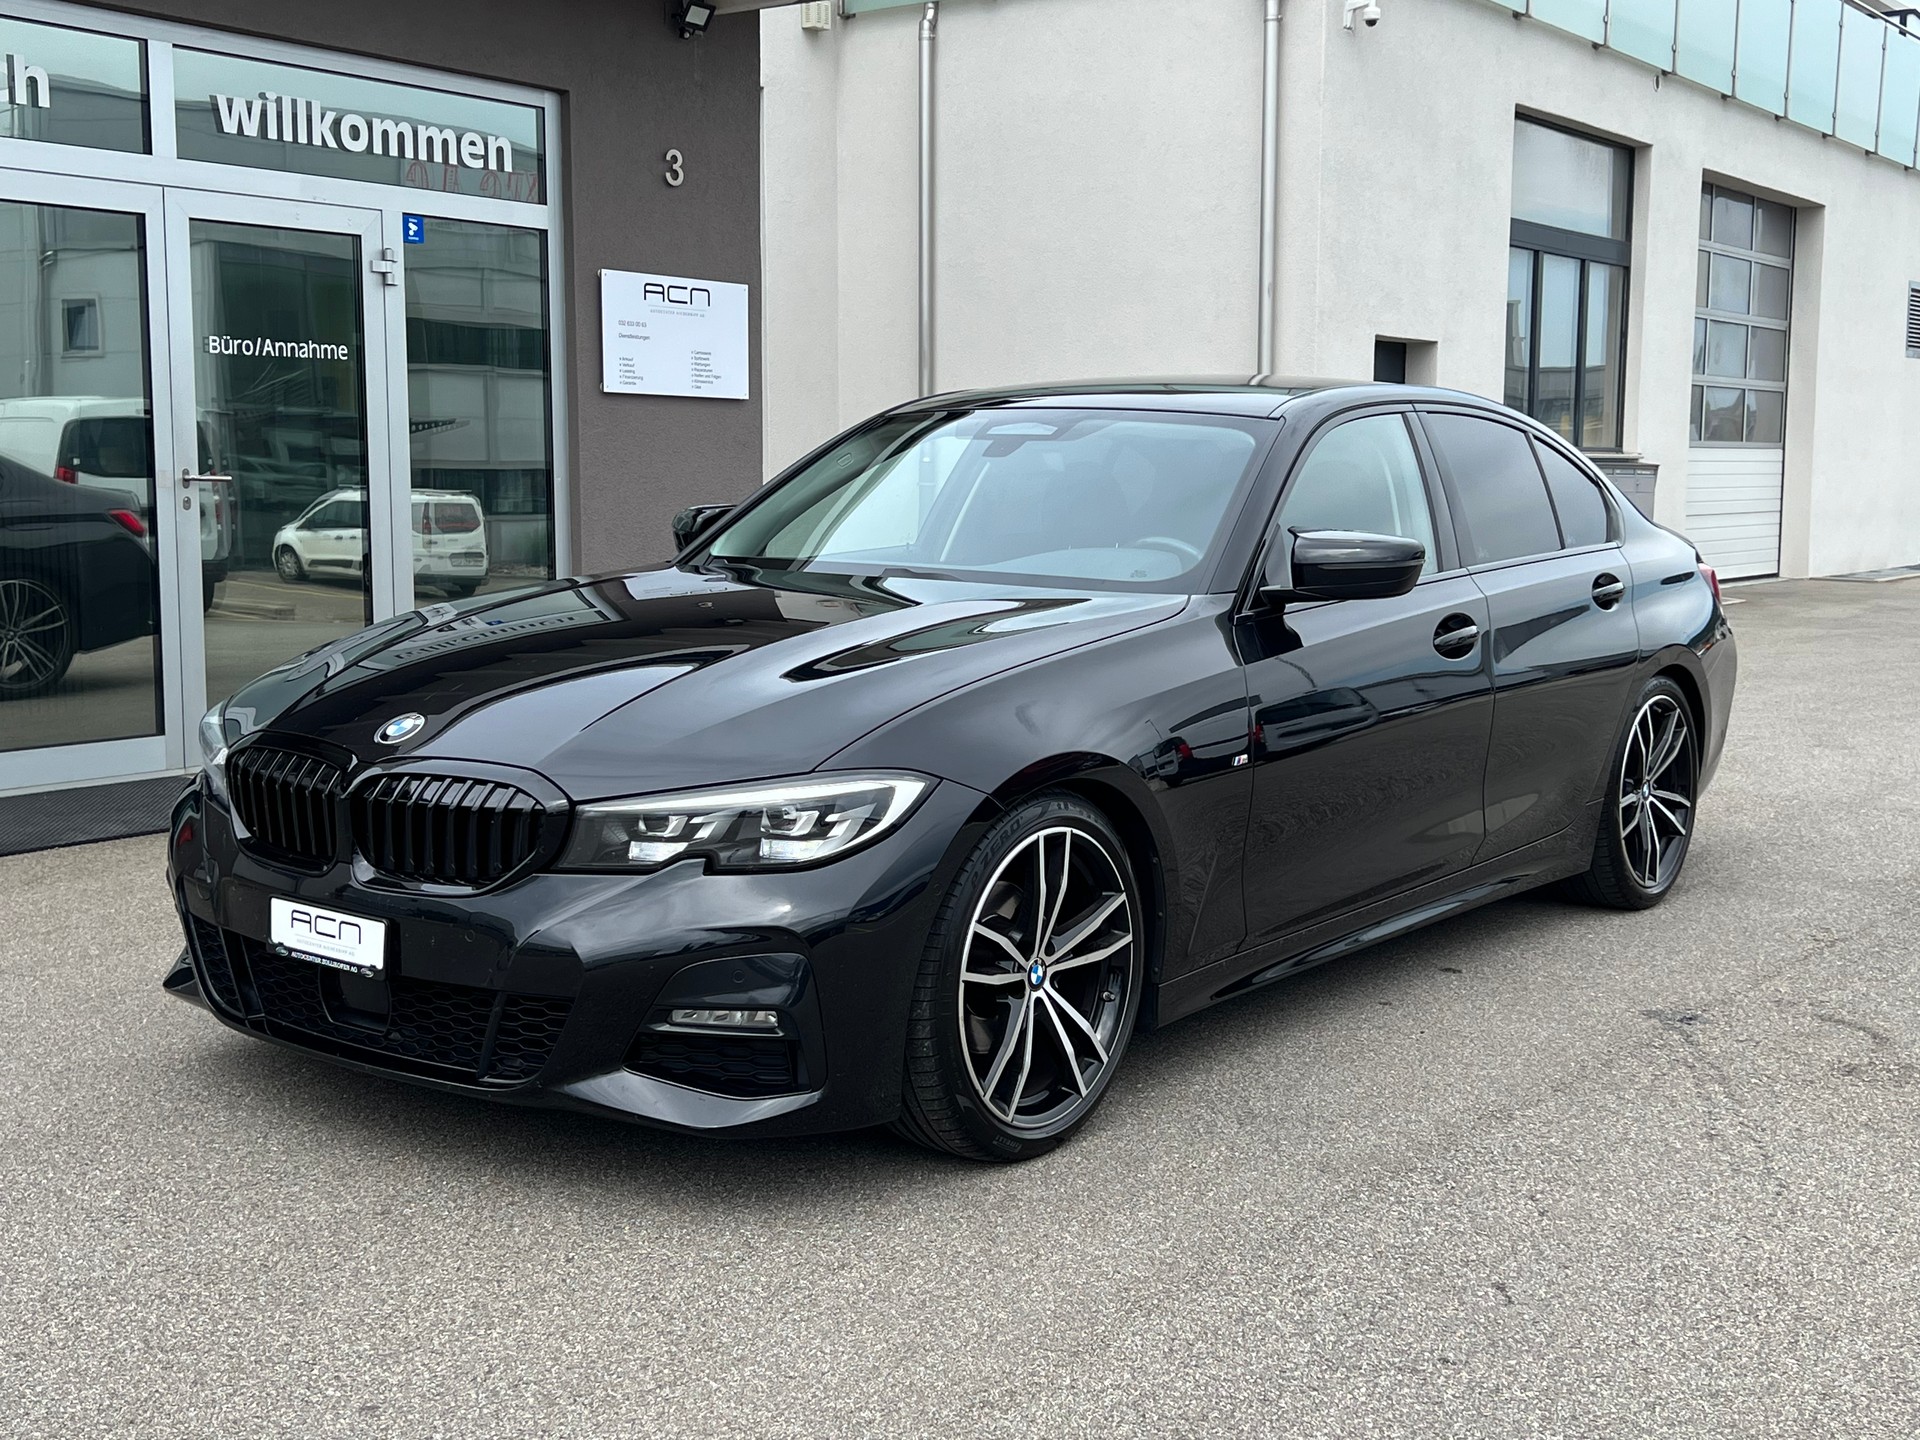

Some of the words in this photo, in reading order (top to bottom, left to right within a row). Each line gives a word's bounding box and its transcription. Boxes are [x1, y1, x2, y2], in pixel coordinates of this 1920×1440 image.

[216, 91, 513, 172] willkommen
[665, 148, 684, 186] 3
[208, 335, 349, 361] Büro/Annahme
[618, 333, 651, 341] Dienstleistungen
[290, 951, 321, 964] AUTOCENTER
